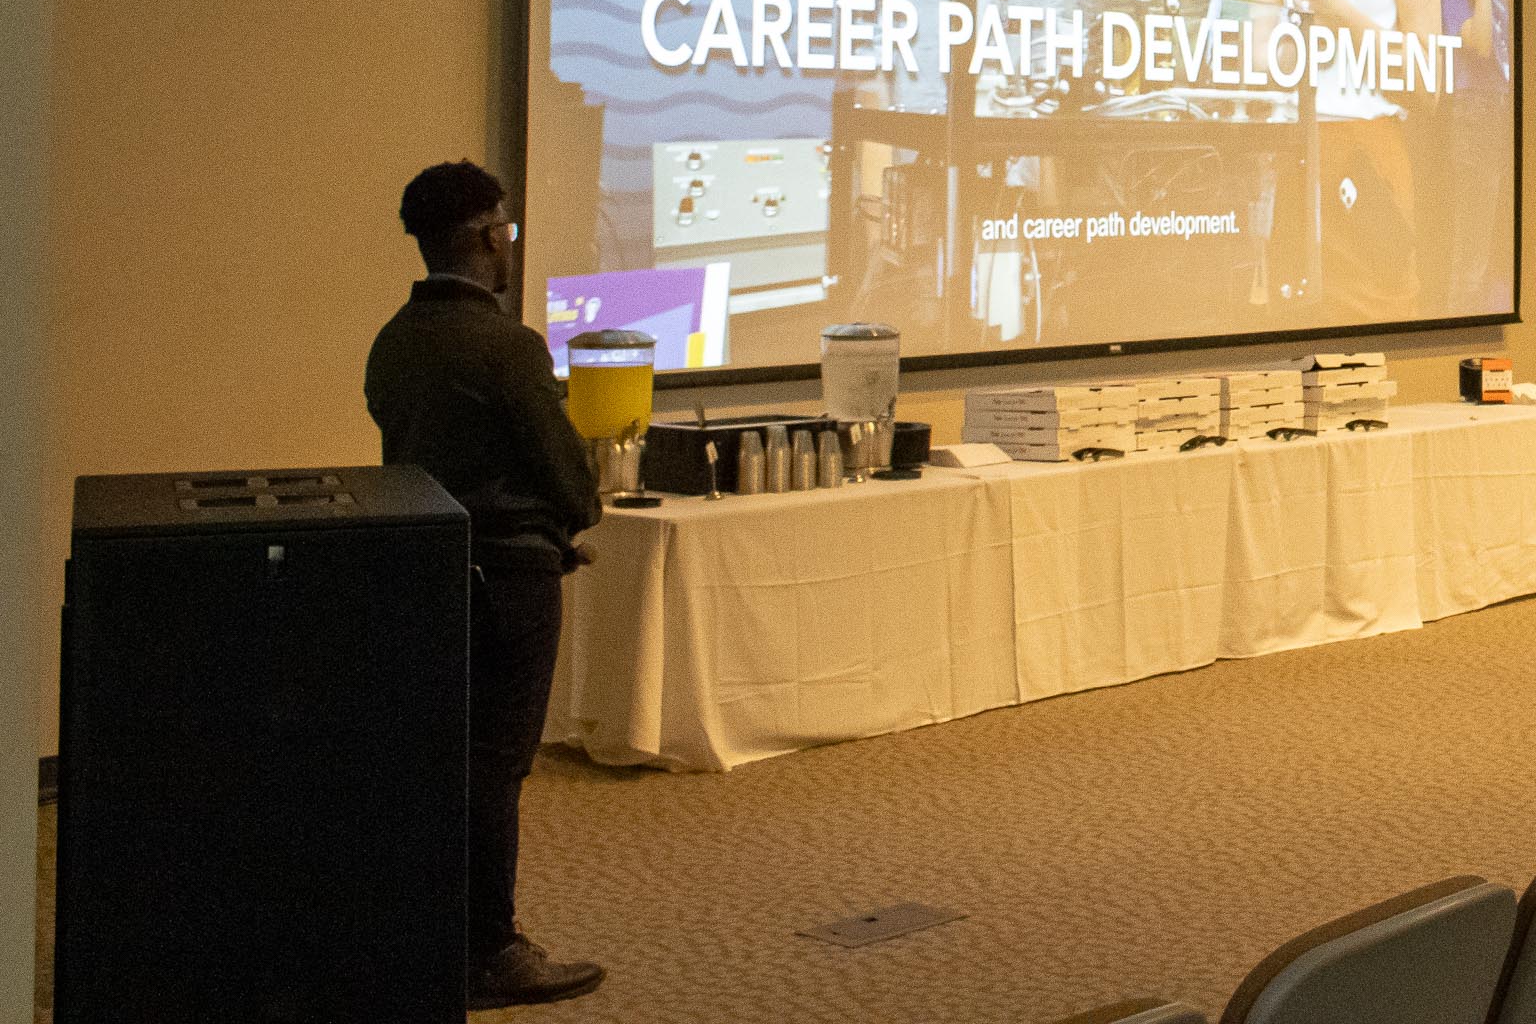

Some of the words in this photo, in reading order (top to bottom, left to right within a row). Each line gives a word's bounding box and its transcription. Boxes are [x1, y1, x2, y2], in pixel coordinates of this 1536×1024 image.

[937, 0, 1083, 78] PATH
[1102, 10, 1462, 94] DEVELOPMENT
[982, 213, 1018, 240] and
[1023, 217, 1082, 239] career
[1087, 212, 1125, 243] path
[1129, 211, 1239, 240] development.
